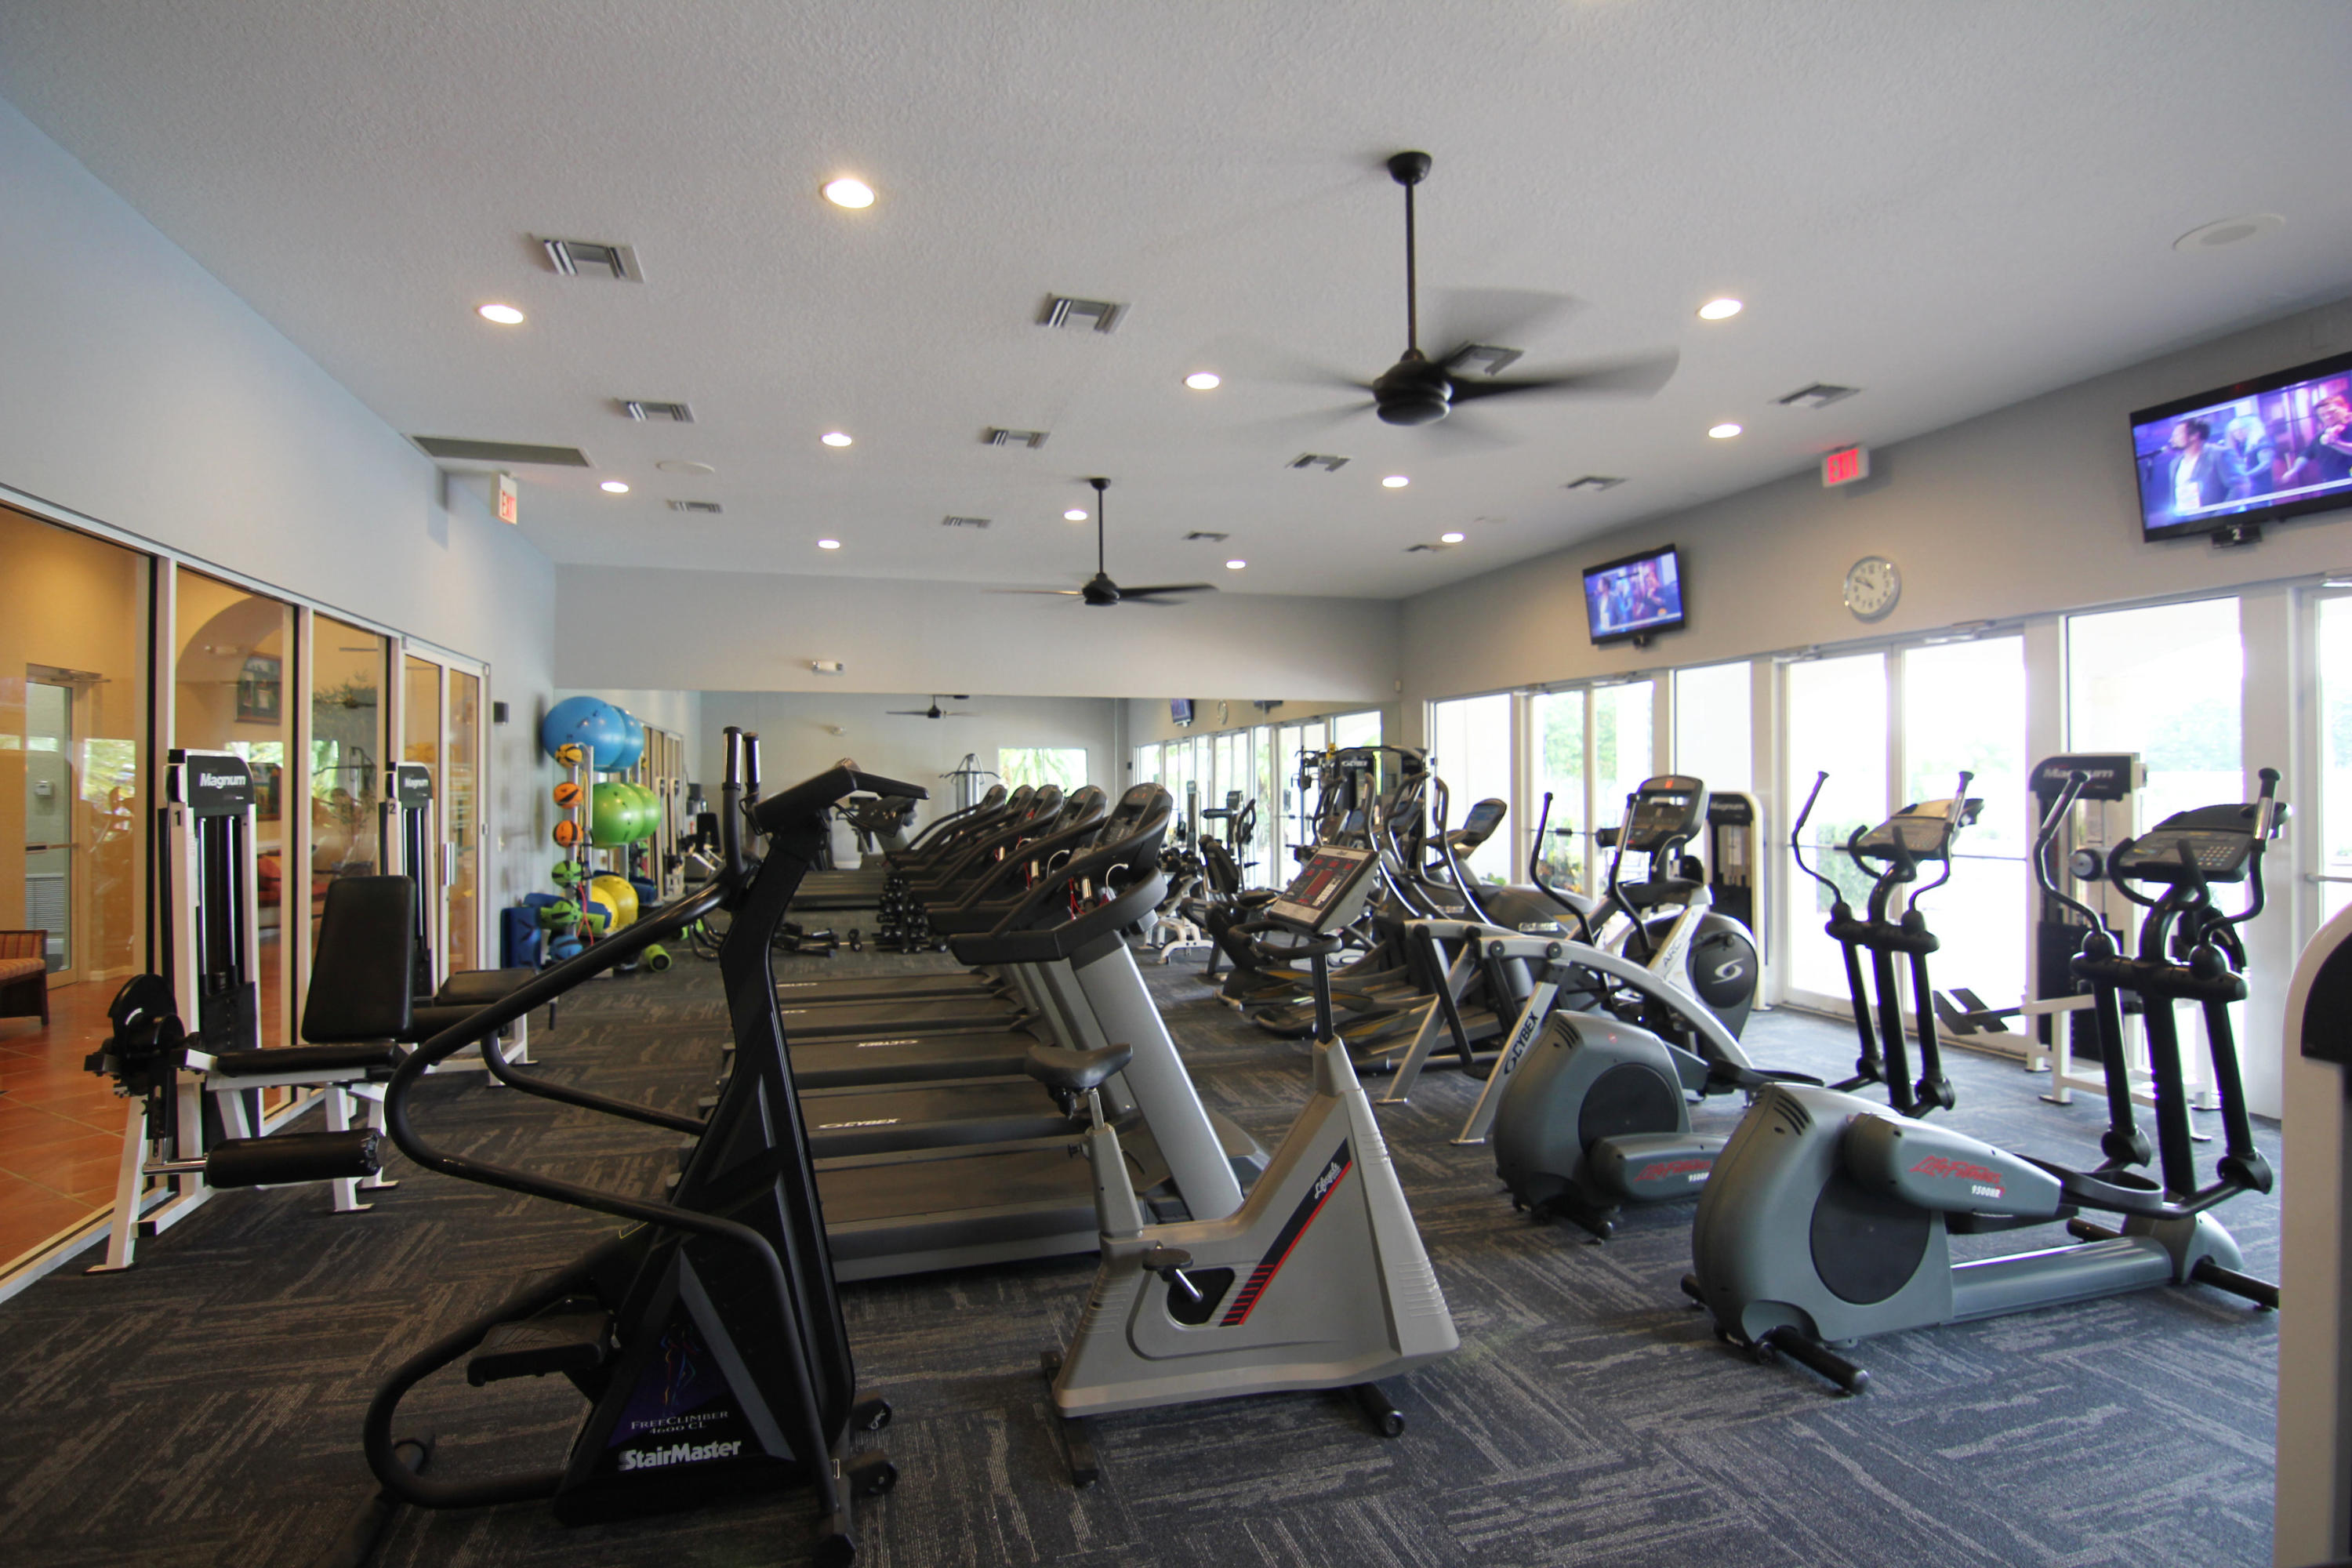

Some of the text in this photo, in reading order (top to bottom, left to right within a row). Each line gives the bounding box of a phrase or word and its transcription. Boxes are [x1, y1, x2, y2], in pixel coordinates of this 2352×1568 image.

[1827, 448, 1859, 484] EXIT
[199, 773, 247, 789] Magnum
[2043, 768, 2114, 781] Maum
[404, 777, 429, 789] Magnum
[389, 803, 397, 815] 2
[175, 811, 181, 826] 1
[1512, 1011, 1539, 1058] CYBEX
[844, 1118, 901, 1127] CYBEX
[1688, 1172, 1711, 1182] 9500H
[1971, 1185, 2002, 1199] 9500HR
[649, 1421, 706, 1435] 4600 CL
[619, 1440, 742, 1472] StairMaster
